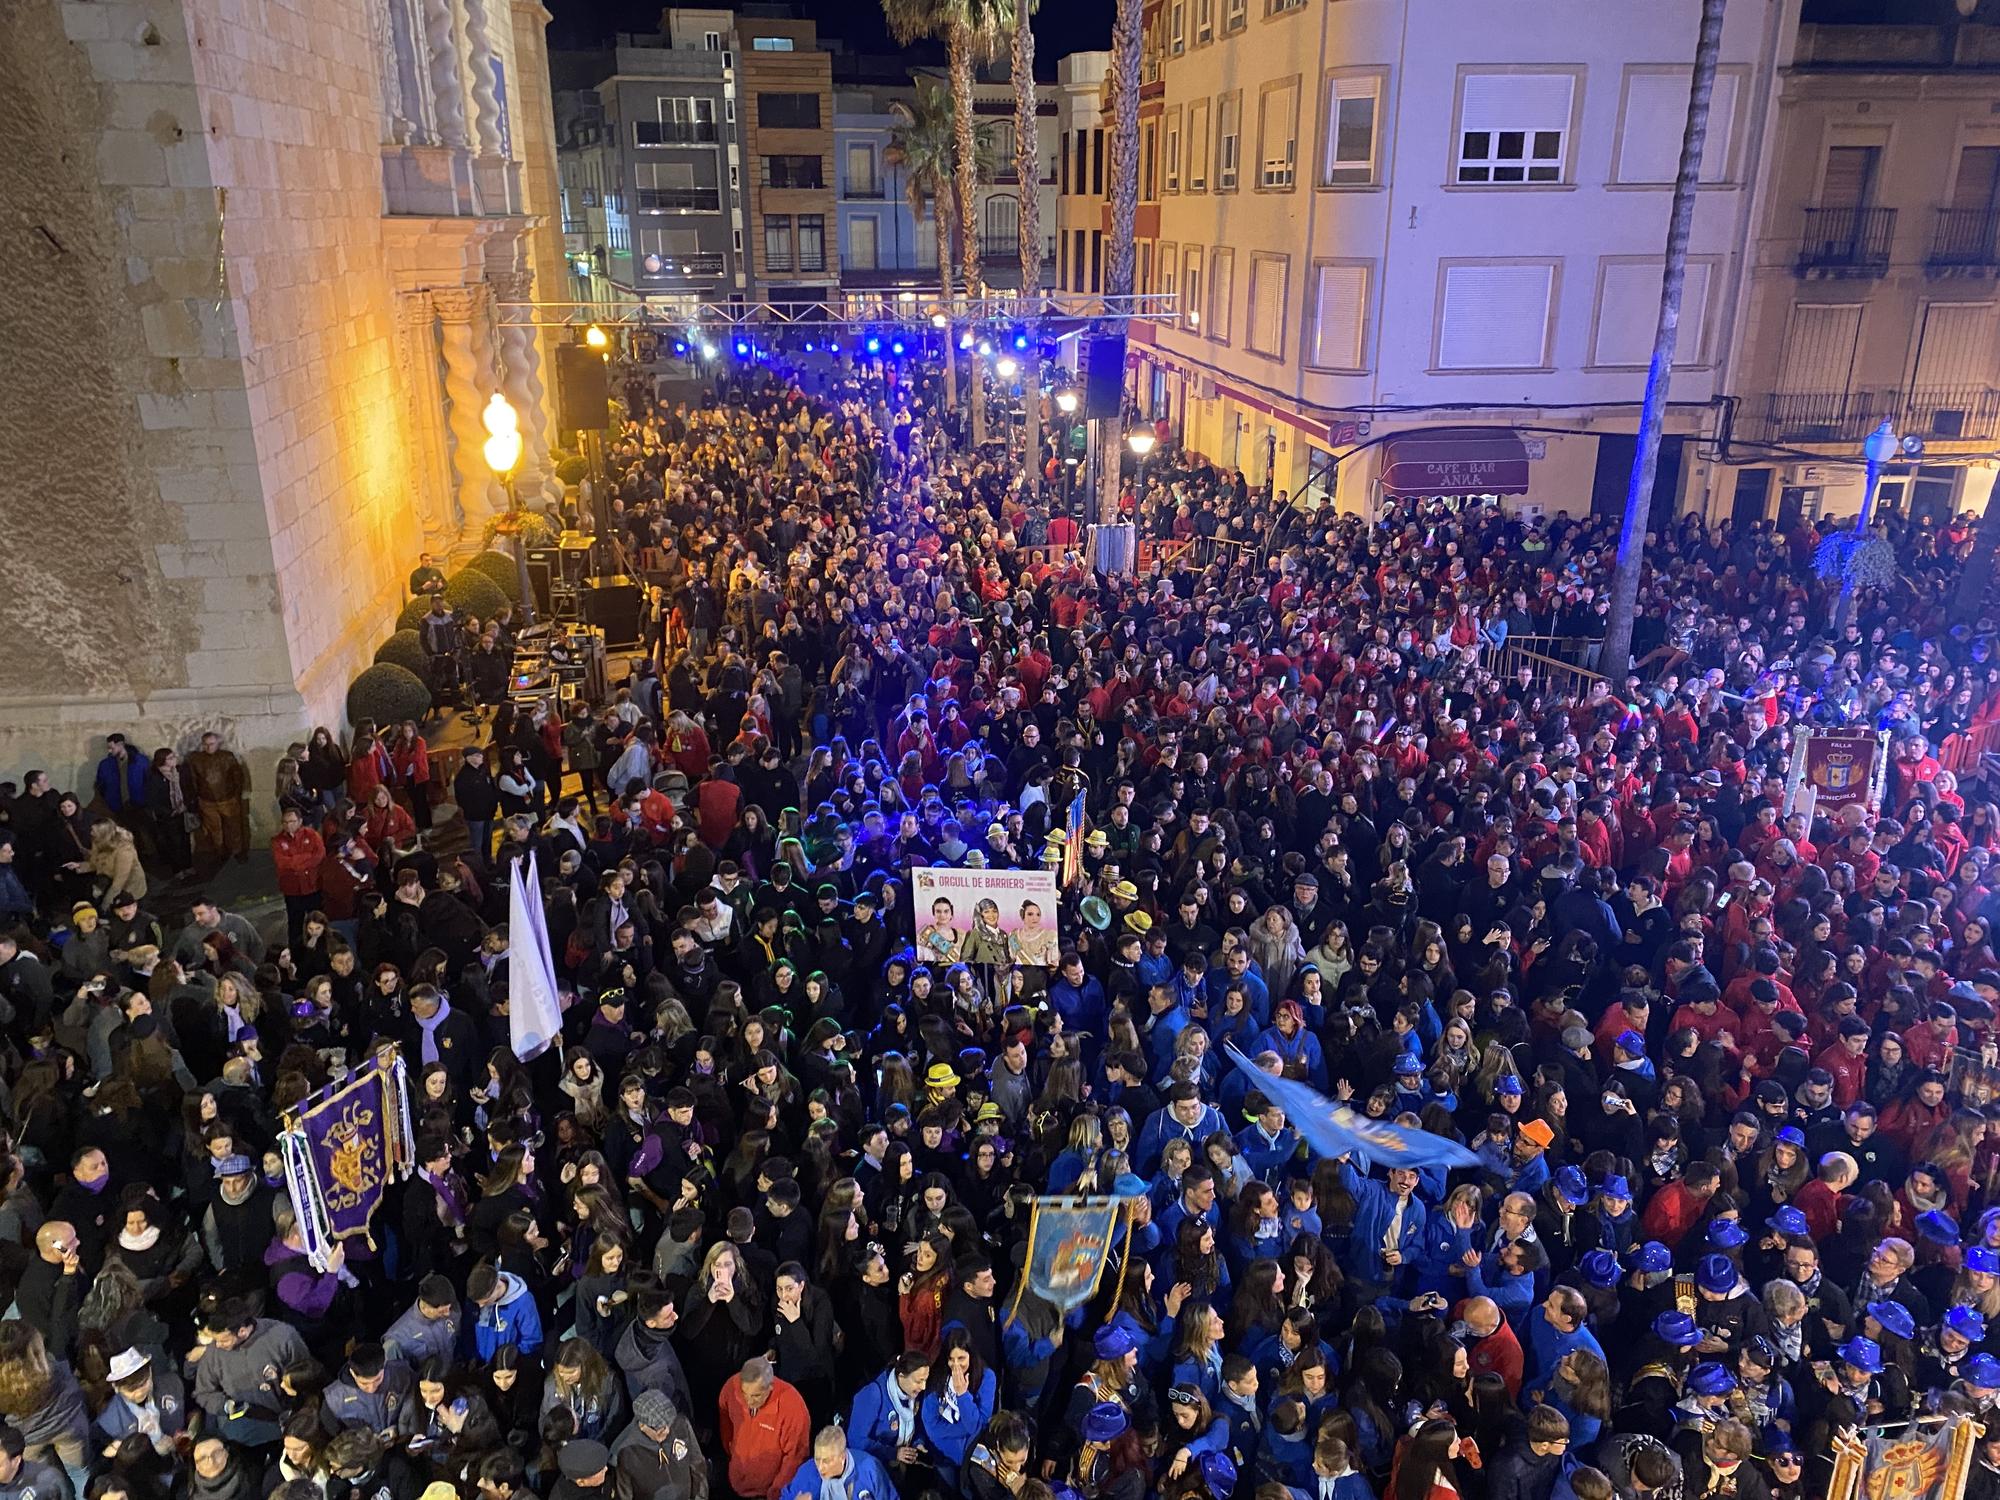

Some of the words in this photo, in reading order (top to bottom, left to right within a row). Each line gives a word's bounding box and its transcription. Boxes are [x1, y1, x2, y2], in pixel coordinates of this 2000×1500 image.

[1428, 463, 1460, 474] CAFE
[1470, 462, 1495, 473] BAR
[1440, 473, 1483, 486] ANNA
[939, 875, 970, 888] ORGULL
[972, 877, 984, 889] DE
[985, 877, 1025, 890] BARRIERS
